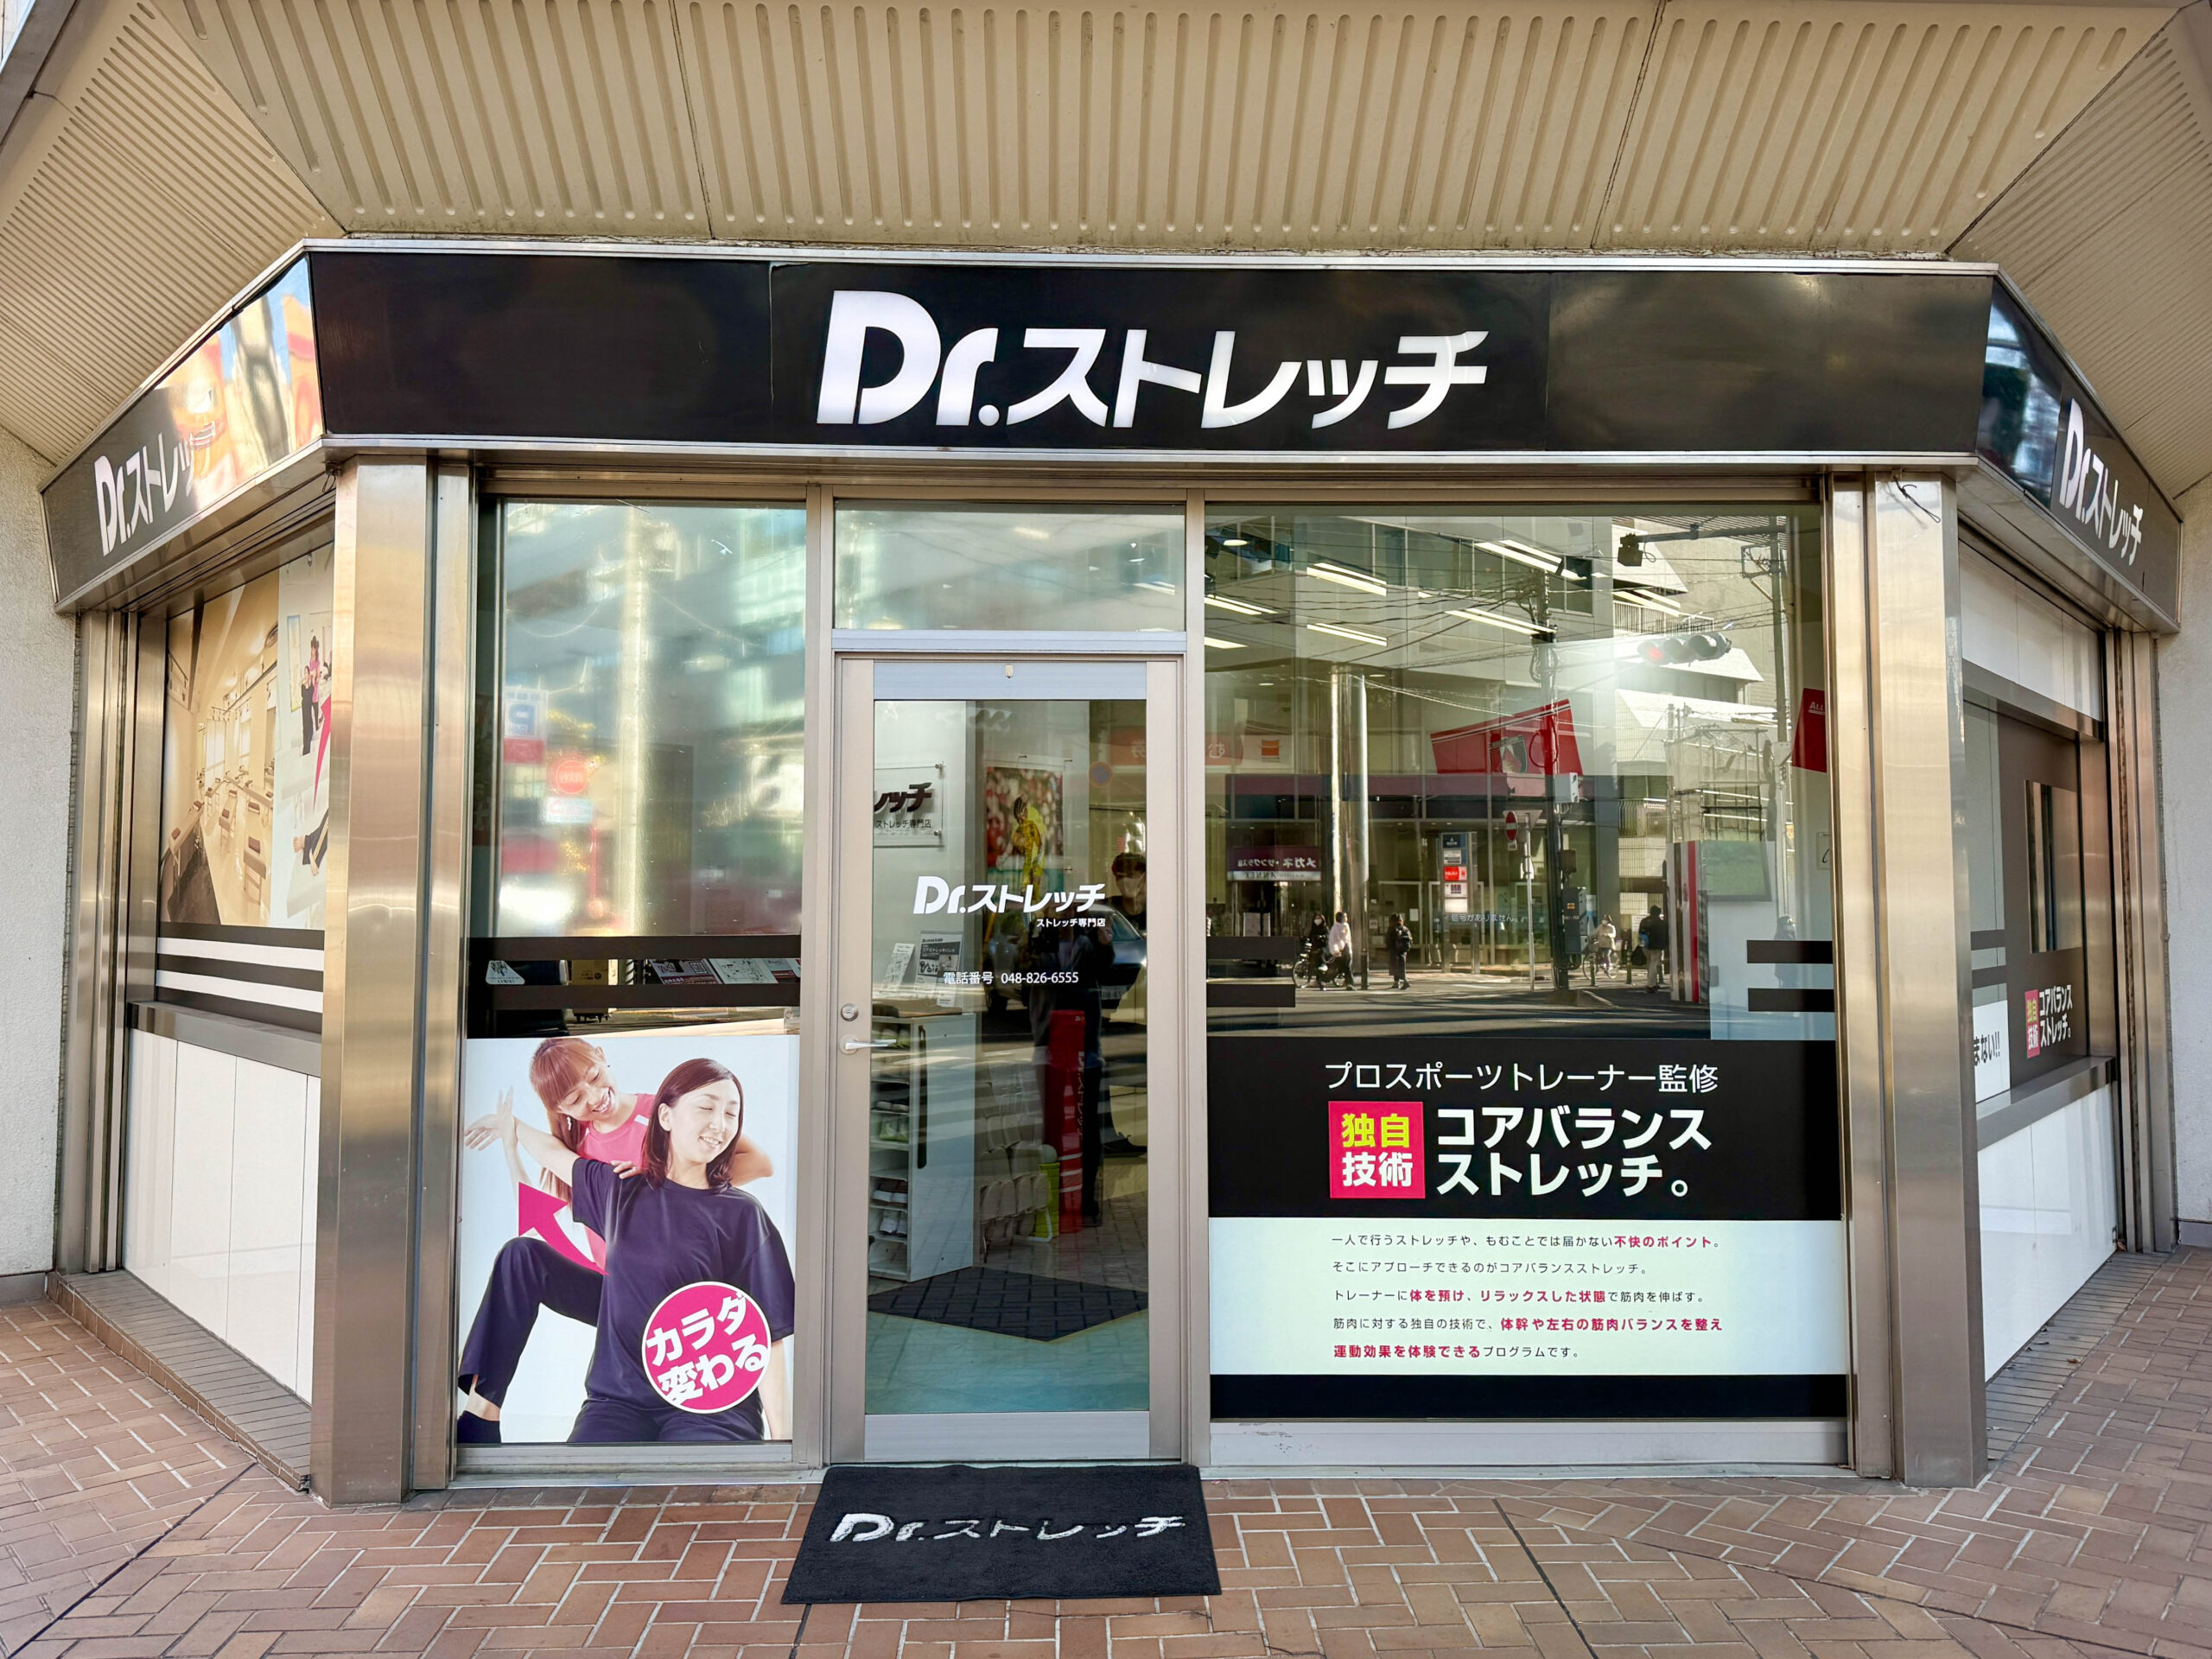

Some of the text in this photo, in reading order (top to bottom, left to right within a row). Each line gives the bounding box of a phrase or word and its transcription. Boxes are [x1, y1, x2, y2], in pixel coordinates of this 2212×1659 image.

[817, 290, 1489, 429] Dr.ストレッチ
[2059, 397, 2143, 566] Dr.ストレッチ
[913, 875, 1106, 915] Dr.ストレッチ
[1037, 918, 1106, 927] ストレッチ専門店
[944, 971, 1079, 986] 電話番号 048-826-6555
[2039, 984, 2073, 1017] コアバランス
[2040, 1013, 2071, 1048] ストレッチ。
[1325, 1061, 1719, 1093] プロスポーツトレーナー監修
[1341, 1113, 1411, 1148] 独自
[1438, 1104, 1712, 1150] コアバランス
[1342, 1151, 1413, 1187] 技術
[1436, 1152, 1688, 1198] ストレッチ。
[1332, 1234, 1719, 1249] 一人で行うストレッチや、もむことでは届かない不快のポイント。
[1332, 1261, 1646, 1274] そこにアプローチできるのがコアバランスストレッチ。
[1335, 1288, 1703, 1303] トレーナーに体を預け、リラックスした状態で筋肉を伸ばす。
[645, 1291, 747, 1367] カラダ
[1333, 1318, 1723, 1332] 筋肉に対する独自の技術で、体幹や左右の筋肉バランスを整え
[1334, 1344, 1579, 1358] 運動効果を体験できるプログラムです。
[657, 1333, 769, 1406] 変わる
[830, 1512, 1186, 1542] Dr.ストレッチ
